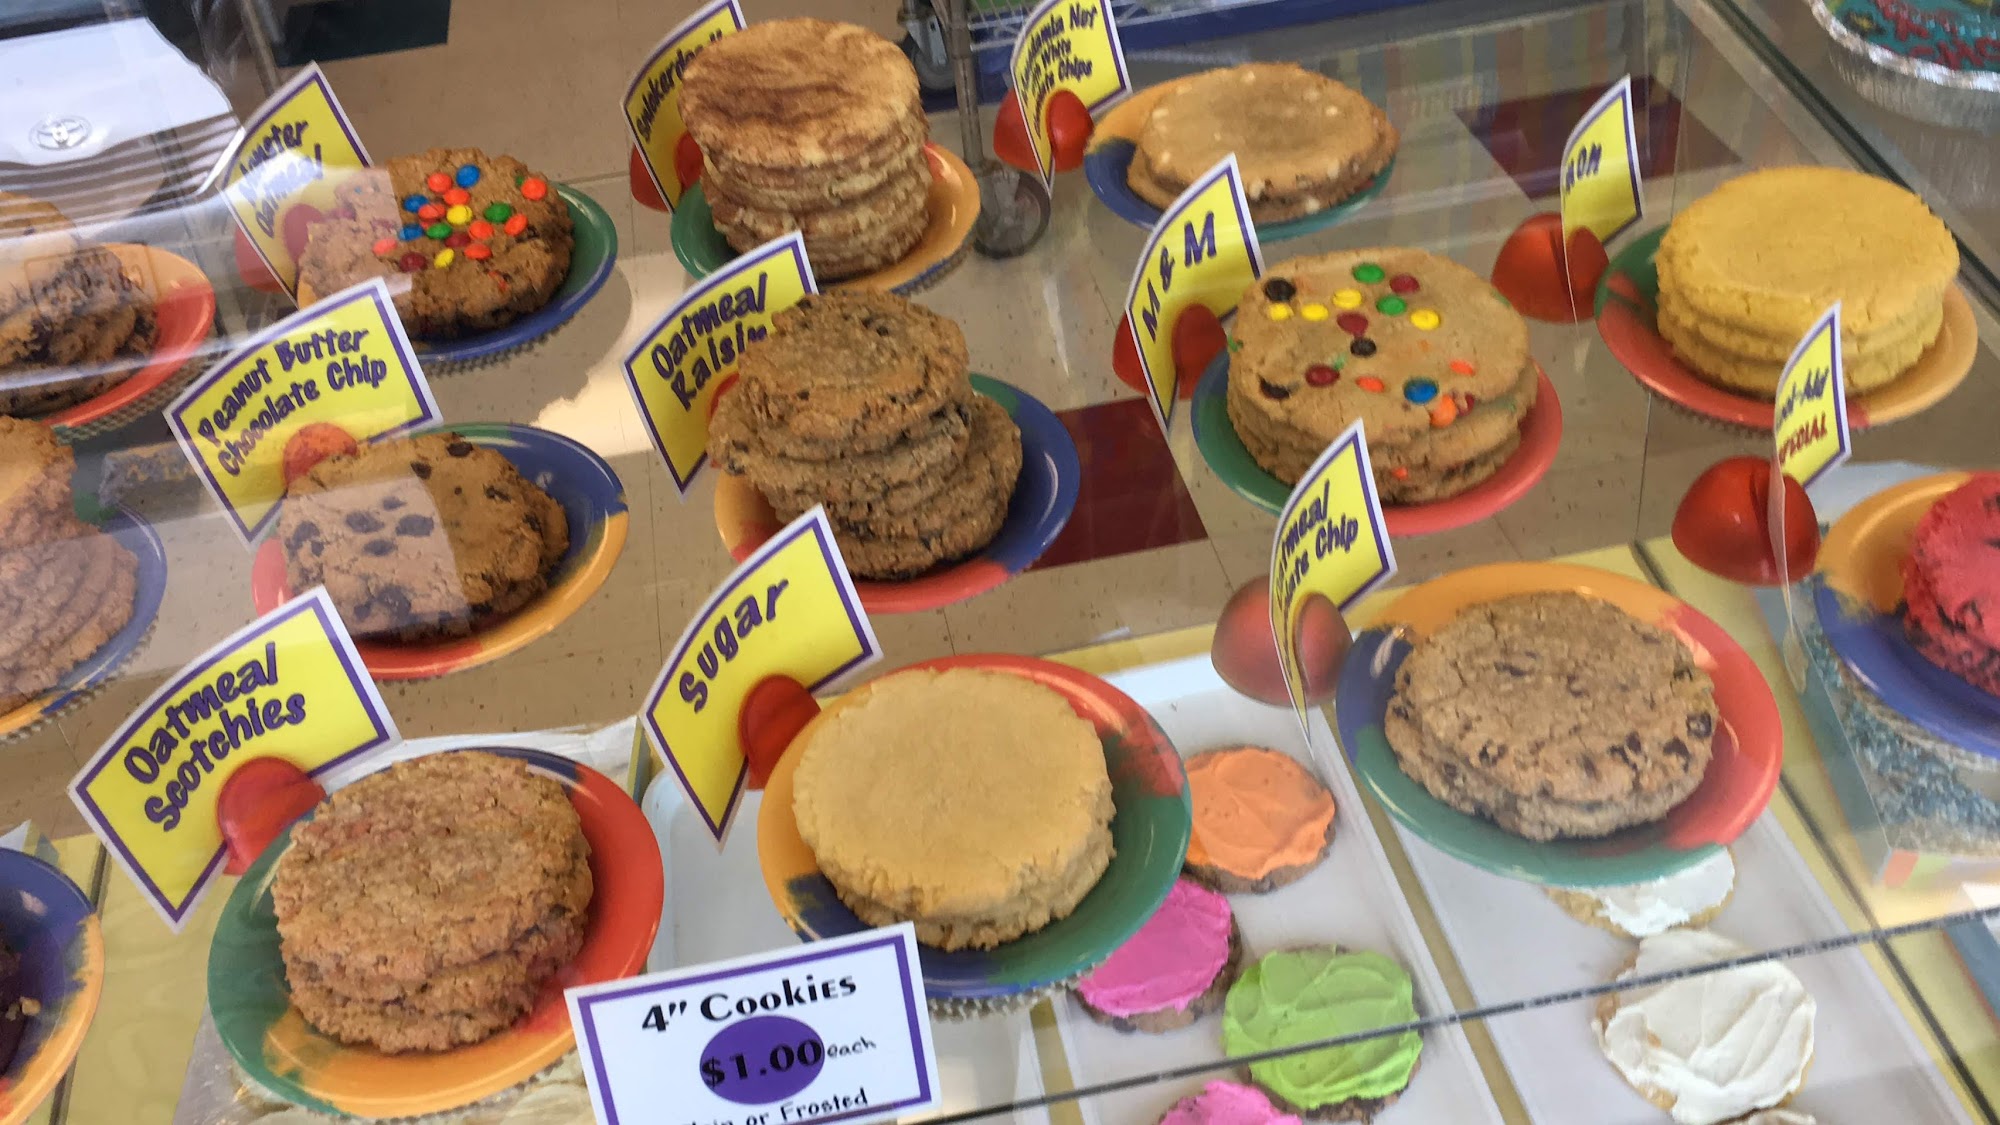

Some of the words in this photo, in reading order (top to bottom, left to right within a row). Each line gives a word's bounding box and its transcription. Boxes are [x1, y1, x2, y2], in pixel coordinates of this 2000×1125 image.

[1069, 2, 1097, 31] Nut
[1562, 142, 1602, 198] MON
[650, 271, 768, 381] Oatmeal
[1142, 278, 1161, 344] M
[1183, 211, 1217, 268] M
[197, 358, 272, 448] Peanut
[274, 328, 369, 373] Butter
[217, 378, 321, 477] Chocolate
[326, 354, 388, 392] Chip
[1315, 512, 1359, 560] Chip
[679, 578, 789, 714] Sugar
[124, 641, 279, 784] Oatmeal
[144, 693, 306, 832] Scotchies
[700, 974, 857, 1022] Cookies
[701, 1038, 824, 1089] $1.00
[827, 1036, 877, 1059] each
[779, 1087, 868, 1123] Frosted
